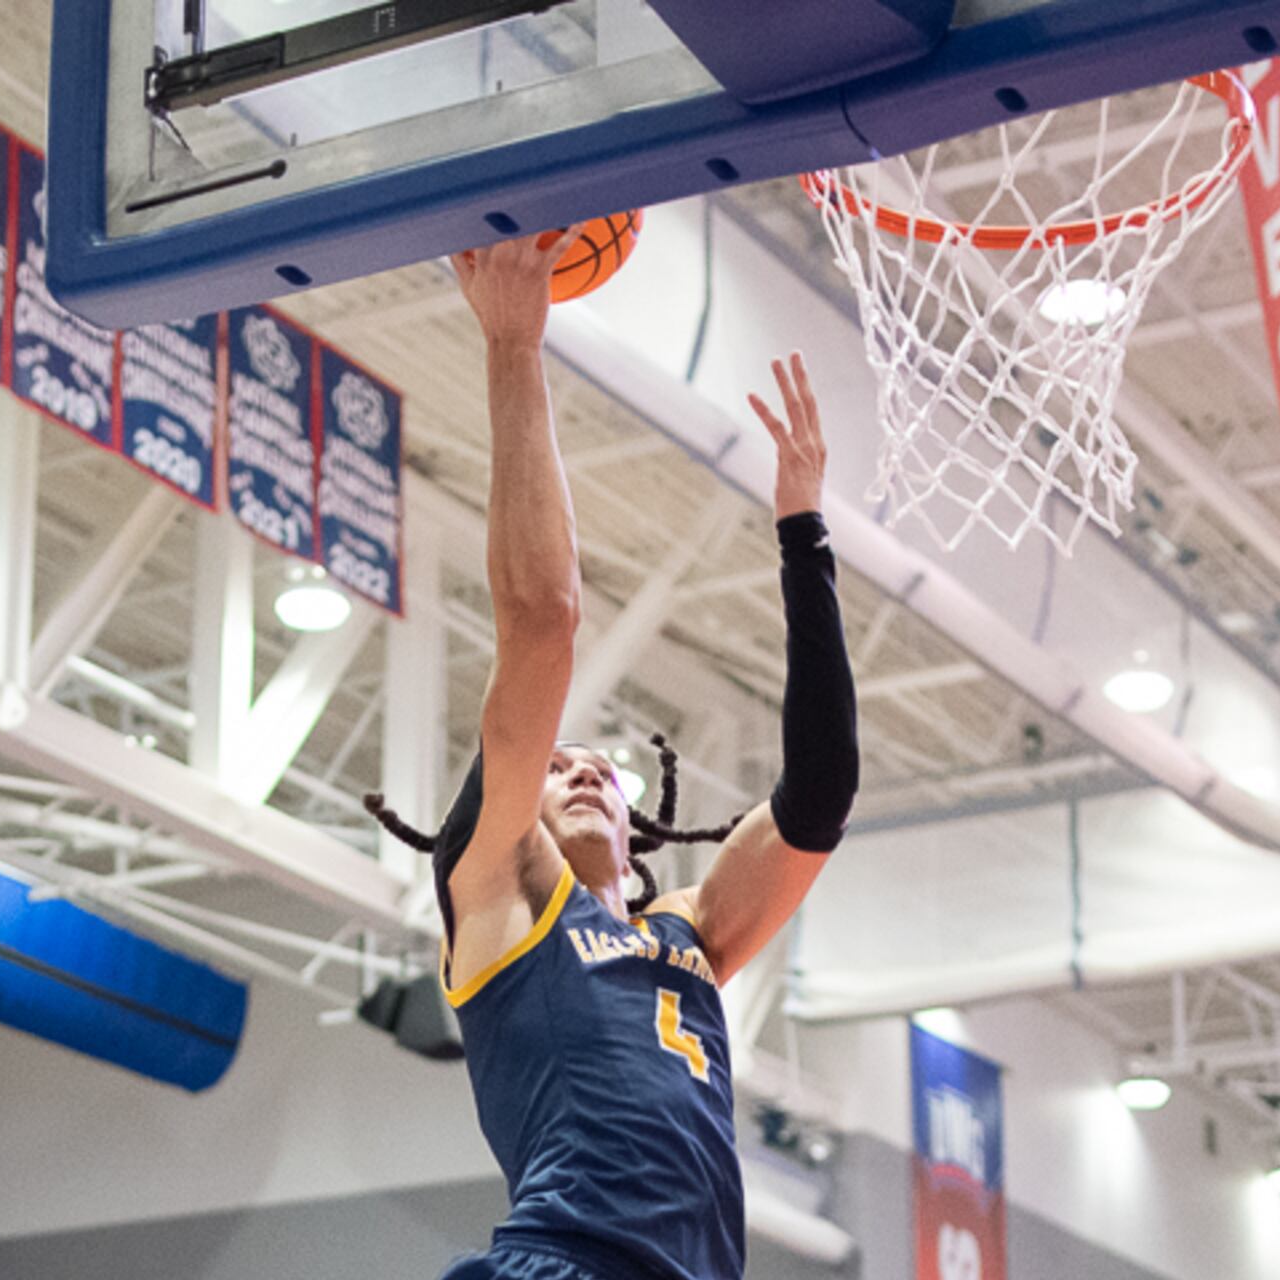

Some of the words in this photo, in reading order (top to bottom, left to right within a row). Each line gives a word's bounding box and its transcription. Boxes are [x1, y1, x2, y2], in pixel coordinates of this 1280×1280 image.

[29, 364, 98, 430] 2019
[239, 489, 300, 550] 2021
[653, 986, 711, 1084] 4
